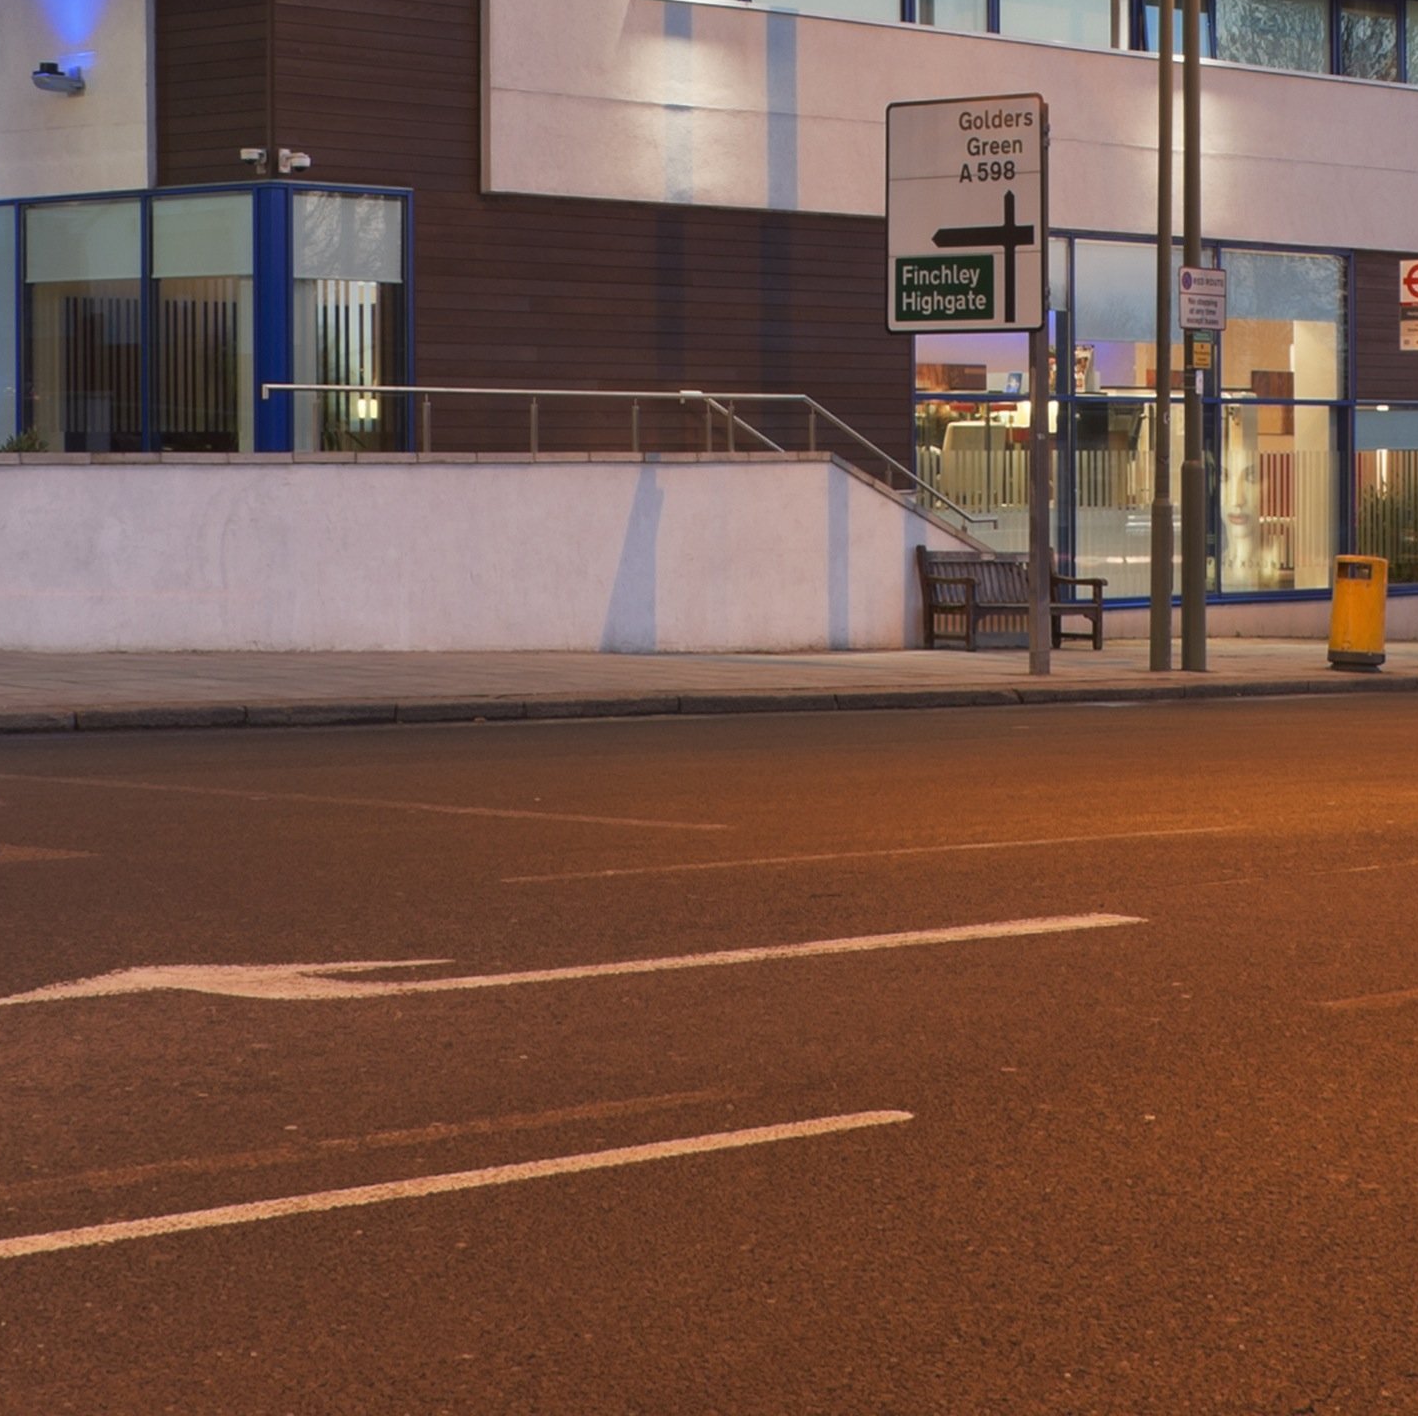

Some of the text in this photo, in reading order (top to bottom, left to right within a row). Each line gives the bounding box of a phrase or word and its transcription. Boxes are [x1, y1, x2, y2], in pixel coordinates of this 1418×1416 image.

[959, 110, 1033, 130] Golders
[967, 137, 1023, 156] Green
[902, 265, 980, 287] Finchley
[1205, 278, 1224, 287] ROUTE
[902, 290, 987, 314] Highgate
